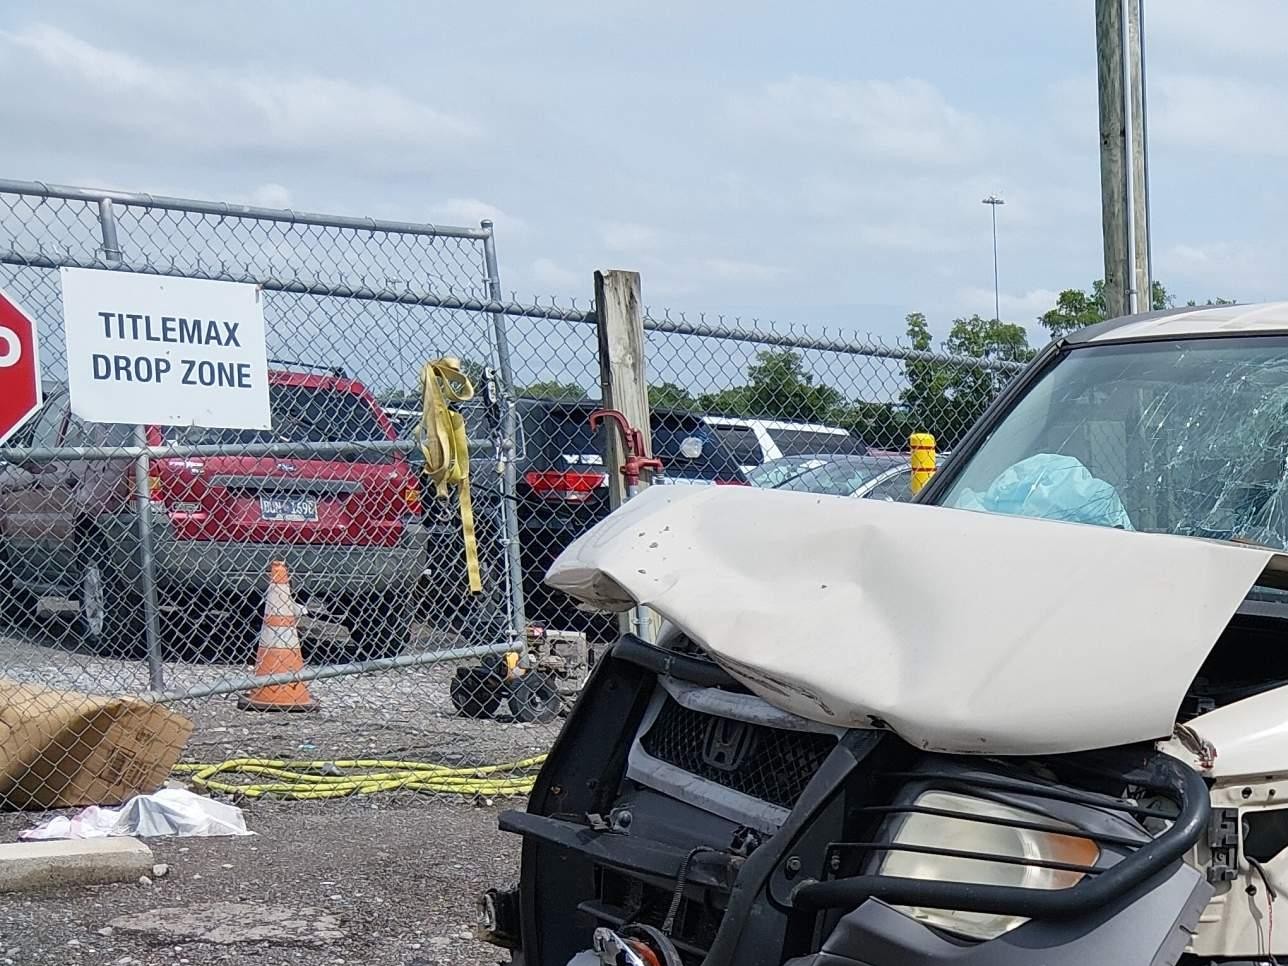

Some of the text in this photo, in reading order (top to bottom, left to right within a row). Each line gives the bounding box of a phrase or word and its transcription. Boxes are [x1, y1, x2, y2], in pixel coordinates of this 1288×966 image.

[98, 312, 241, 347] TITLEMAX
[92, 354, 252, 388] DROP ZONE
